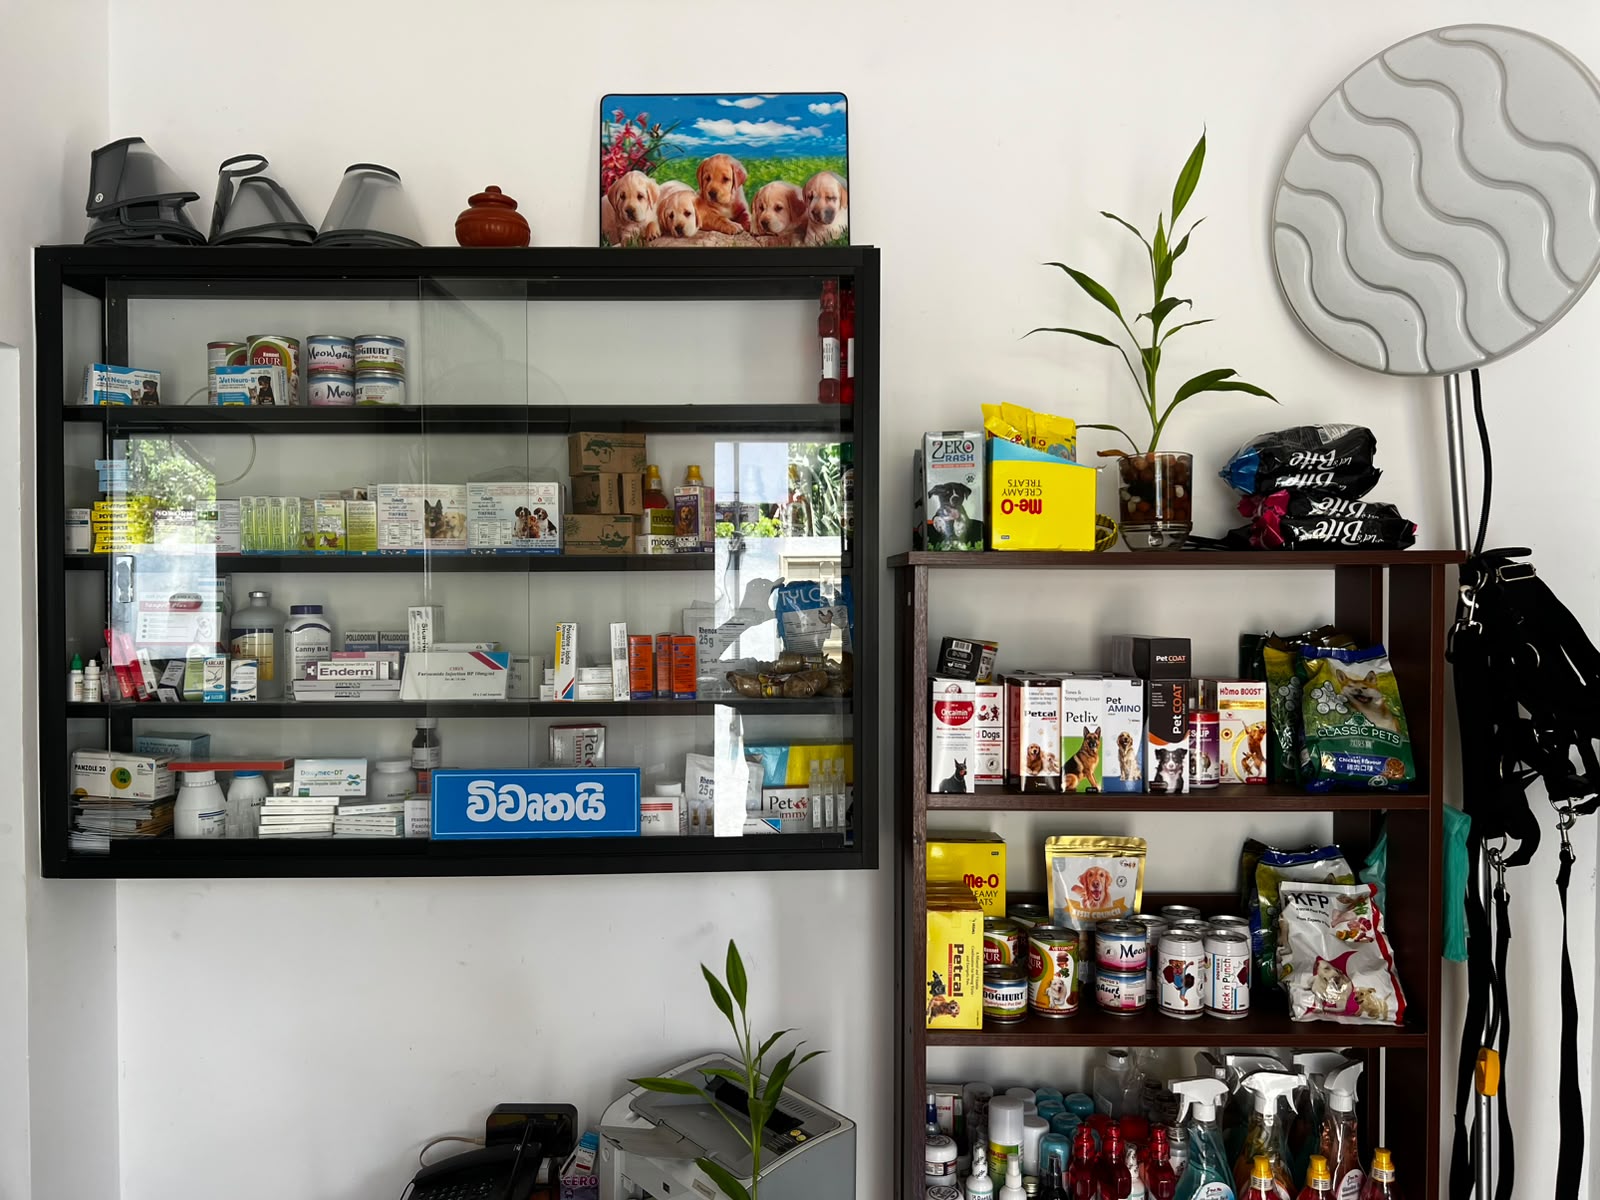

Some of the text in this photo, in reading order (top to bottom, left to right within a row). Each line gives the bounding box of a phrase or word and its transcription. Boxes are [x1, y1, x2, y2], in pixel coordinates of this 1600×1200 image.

[253, 357, 280, 366] FOUR
[932, 440, 974, 460] ZERO
[1290, 449, 1336, 471] Bite
[1315, 520, 1363, 545] Bite
[1173, 684, 1182, 713] COAT
[1066, 711, 1098, 723] Petliv
[1173, 714, 1182, 734] Pet
[982, 730, 1000, 740] Dogs
[1318, 726, 1400, 744] CLASSIC PETS
[585, 734, 598, 758] Pet
[770, 796, 791, 810] Pet
[1292, 893, 1329, 908] KFP
[953, 944, 964, 997] Petcal
[1222, 958, 1231, 983] Punch
[1222, 992, 1230, 1010] Kick
